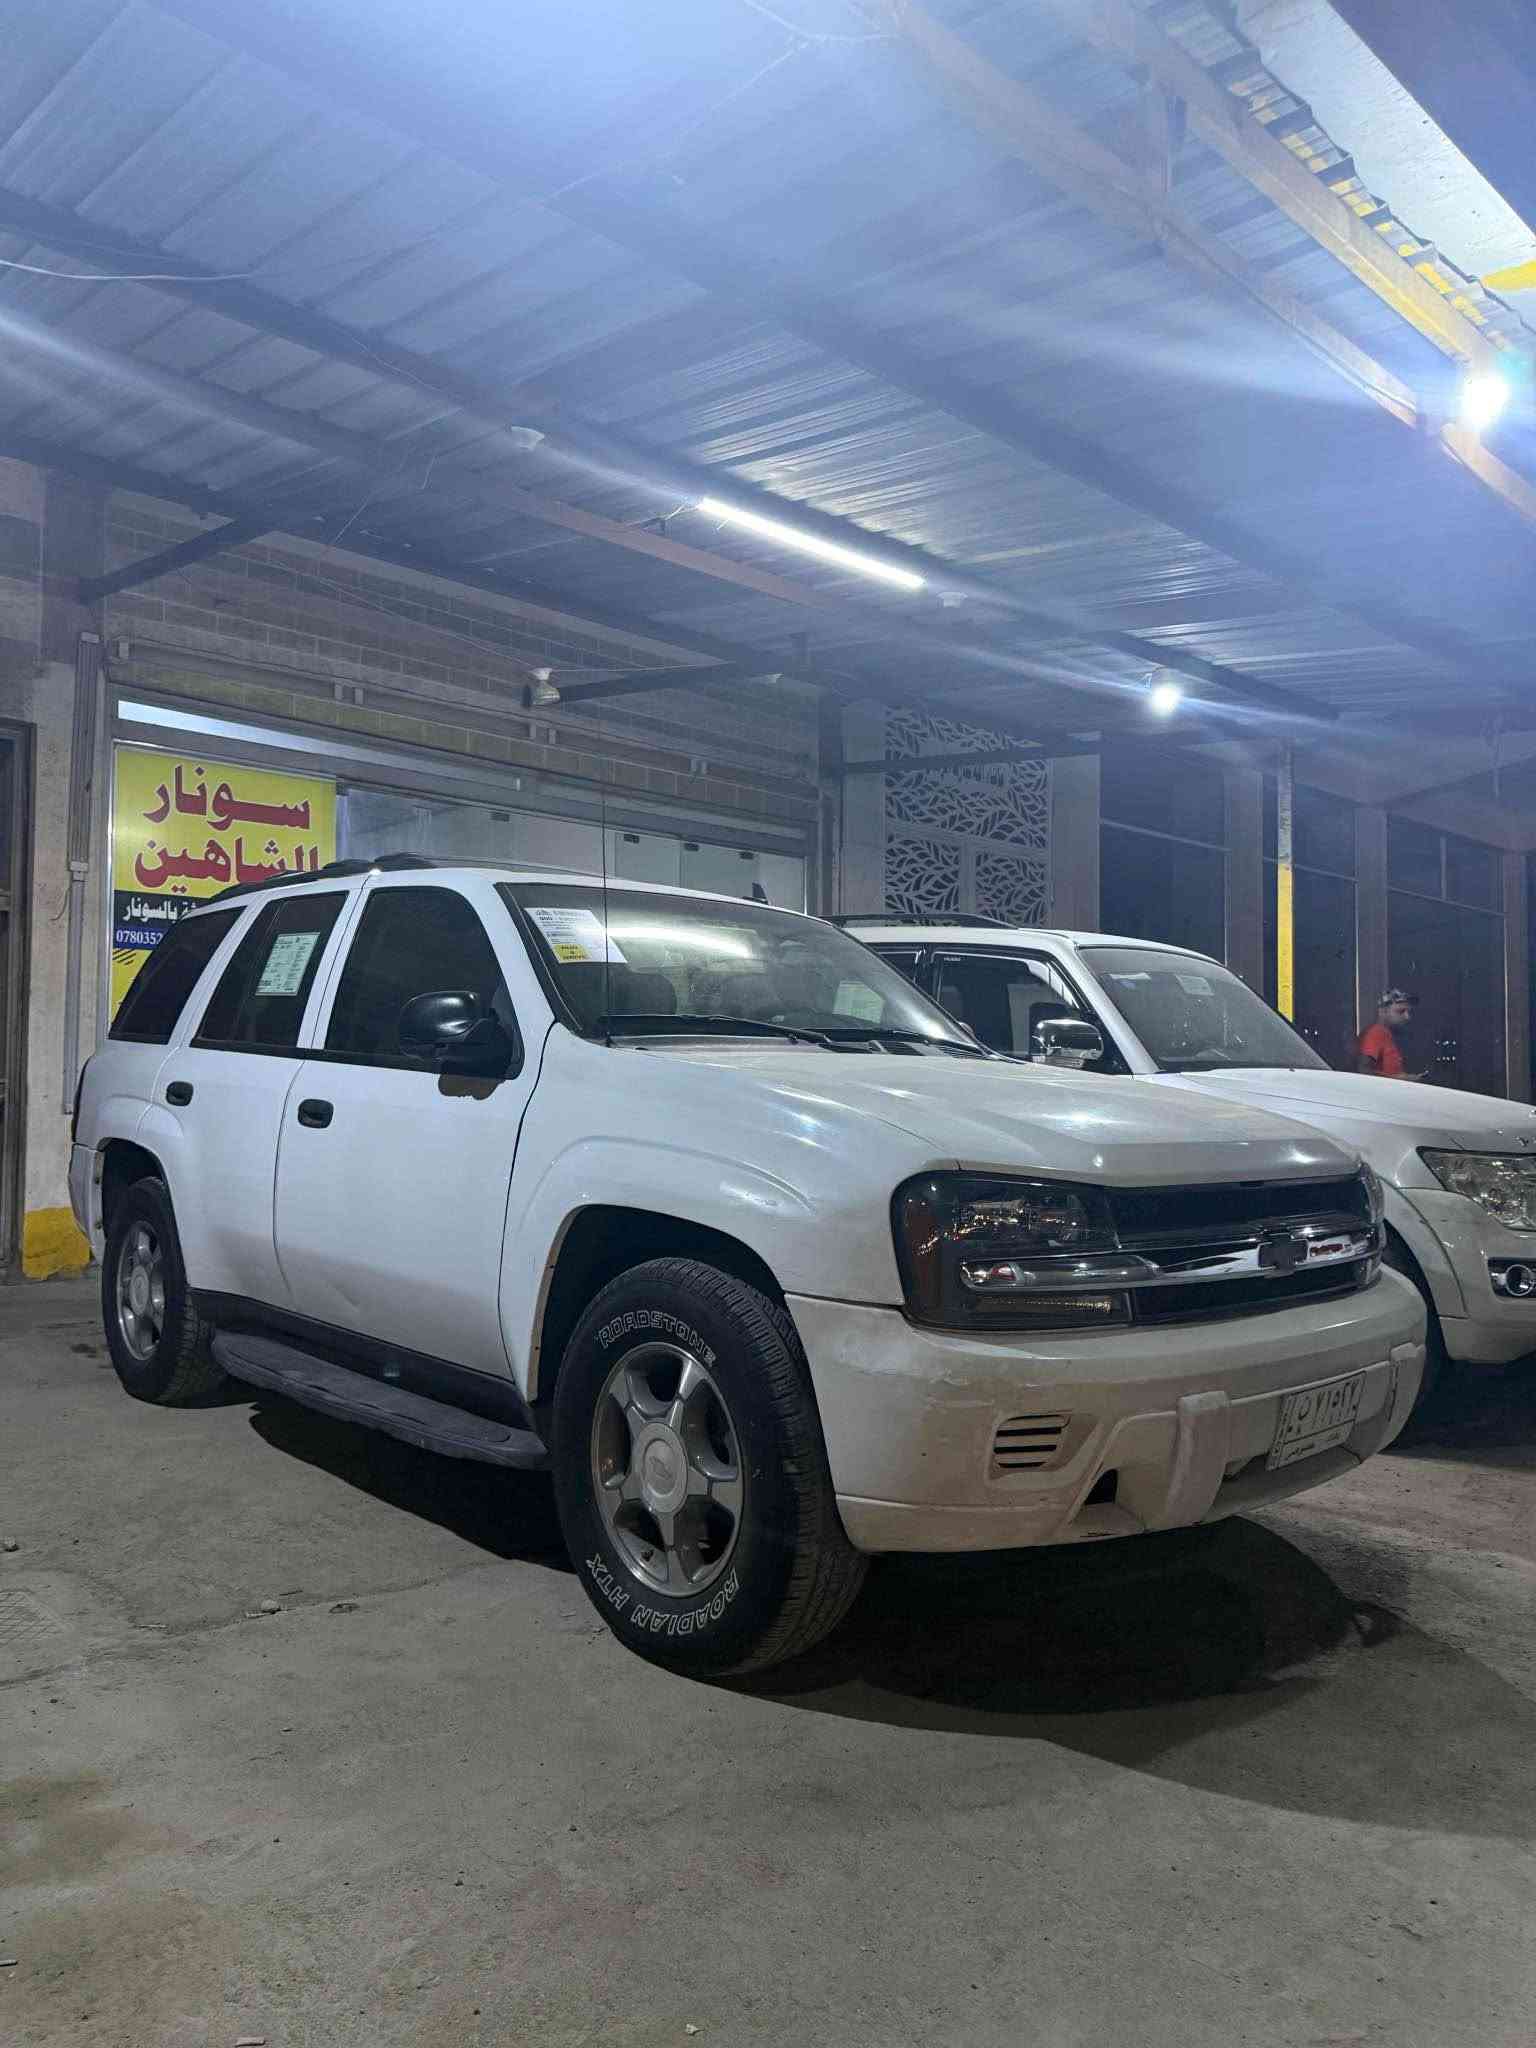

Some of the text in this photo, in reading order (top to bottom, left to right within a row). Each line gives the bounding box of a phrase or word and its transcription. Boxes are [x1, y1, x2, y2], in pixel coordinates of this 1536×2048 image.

[143, 764, 310, 831] سونار
[122, 897, 177, 924] بالسونار
[599, 1310, 717, 1367] ROADSTONE
[586, 1553, 740, 1636] ROADIAN HTX
